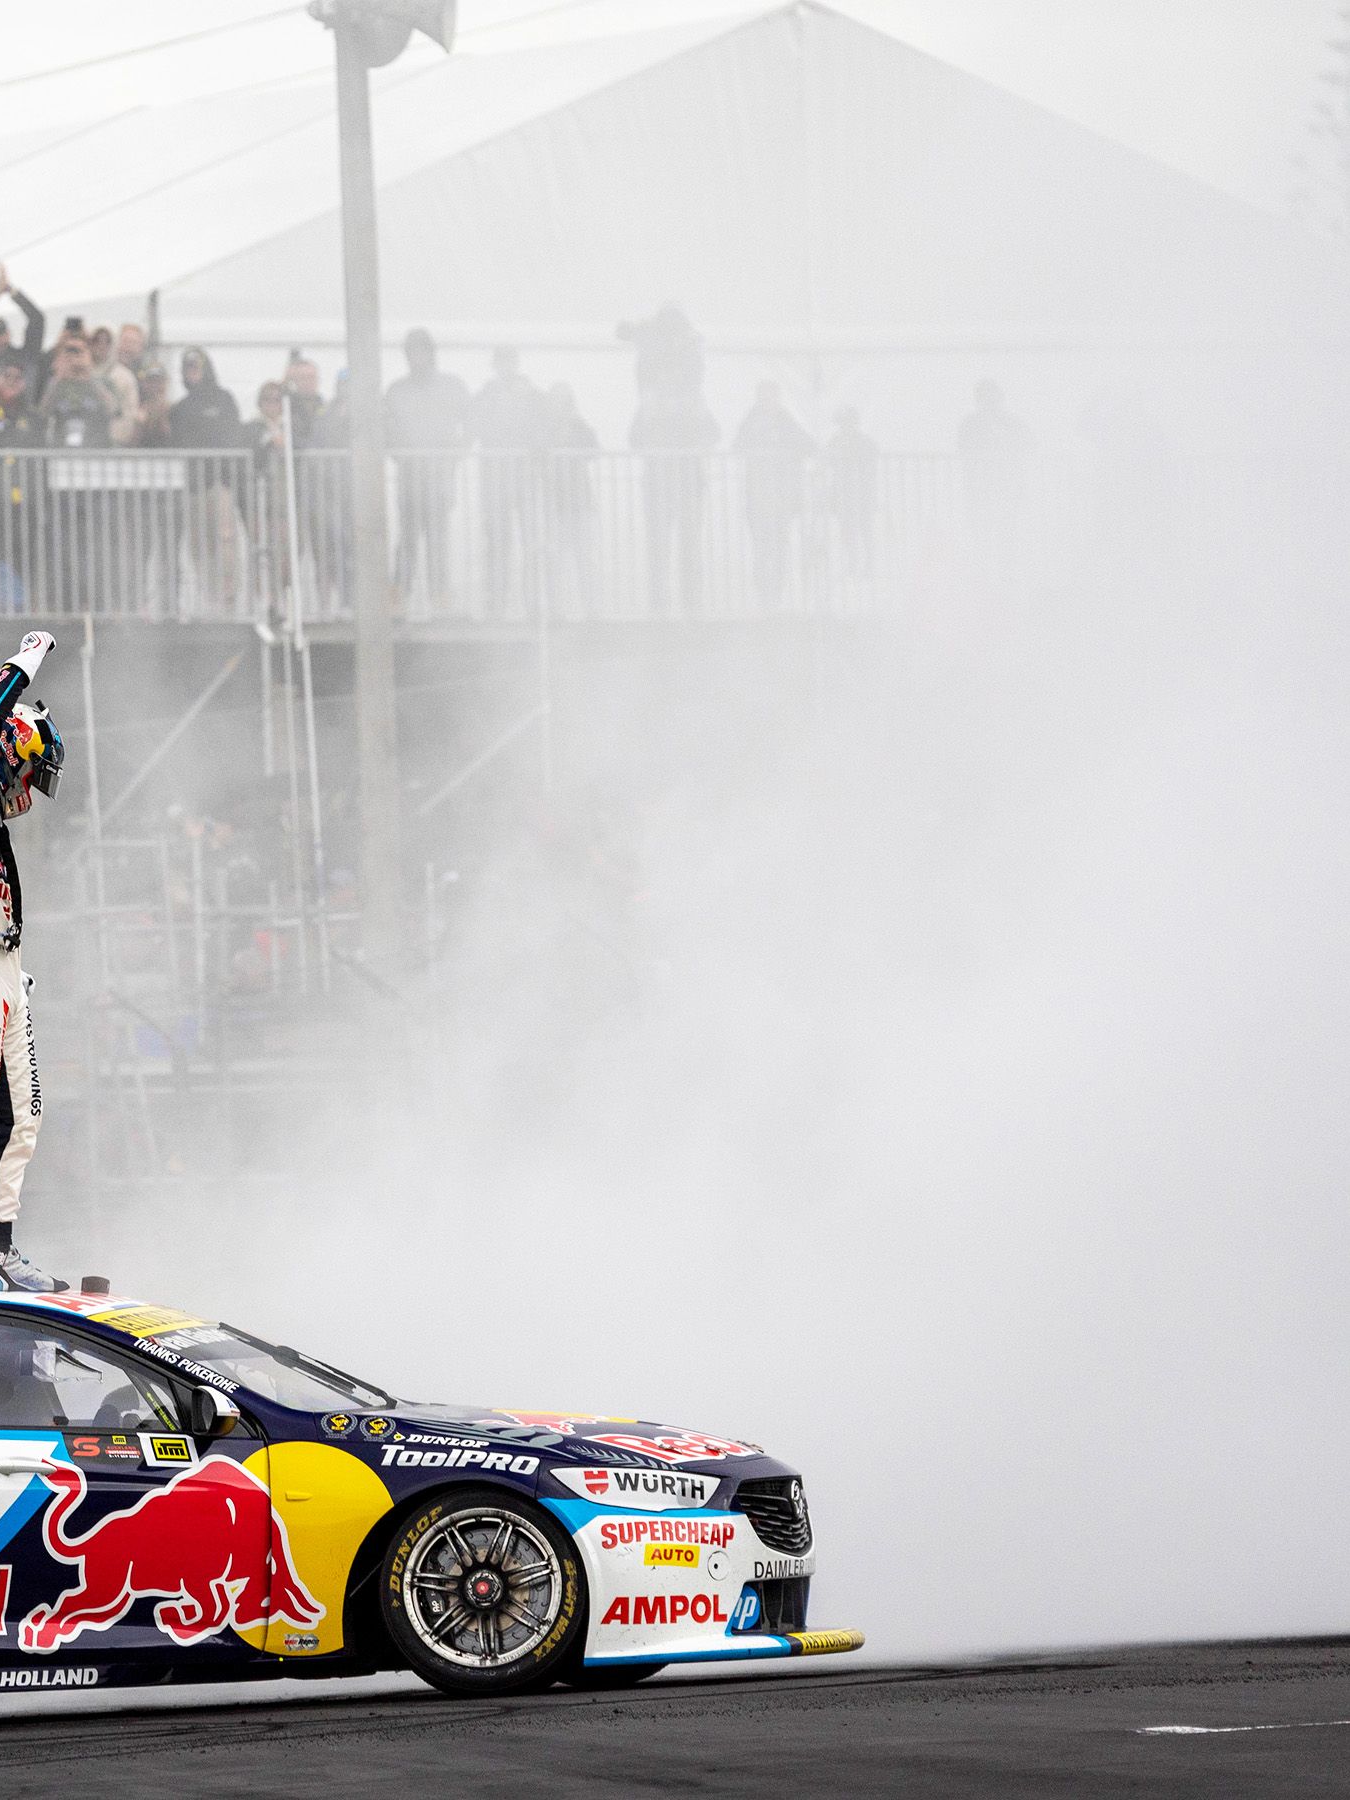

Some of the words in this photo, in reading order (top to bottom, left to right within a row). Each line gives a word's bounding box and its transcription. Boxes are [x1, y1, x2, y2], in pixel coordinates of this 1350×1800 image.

[28, 1039, 37, 1067] YOU
[31, 1069, 41, 1117] WINGS
[133, 1337, 178, 1365] THANKS
[177, 1358, 240, 1394] PUKEKOHE
[407, 1433, 490, 1448] DUNLOP
[381, 1444, 540, 1475] ToolPRO
[614, 1472, 705, 1500] WÜRTH
[389, 1505, 443, 1592] DUNLOP
[601, 1520, 735, 1549] SUPERCHEAP
[651, 1548, 694, 1562] AUTO
[754, 1559, 805, 1578] DAIMLER
[601, 1594, 727, 1625] AMPOL
[0, 1667, 99, 1687] HOLLAND
